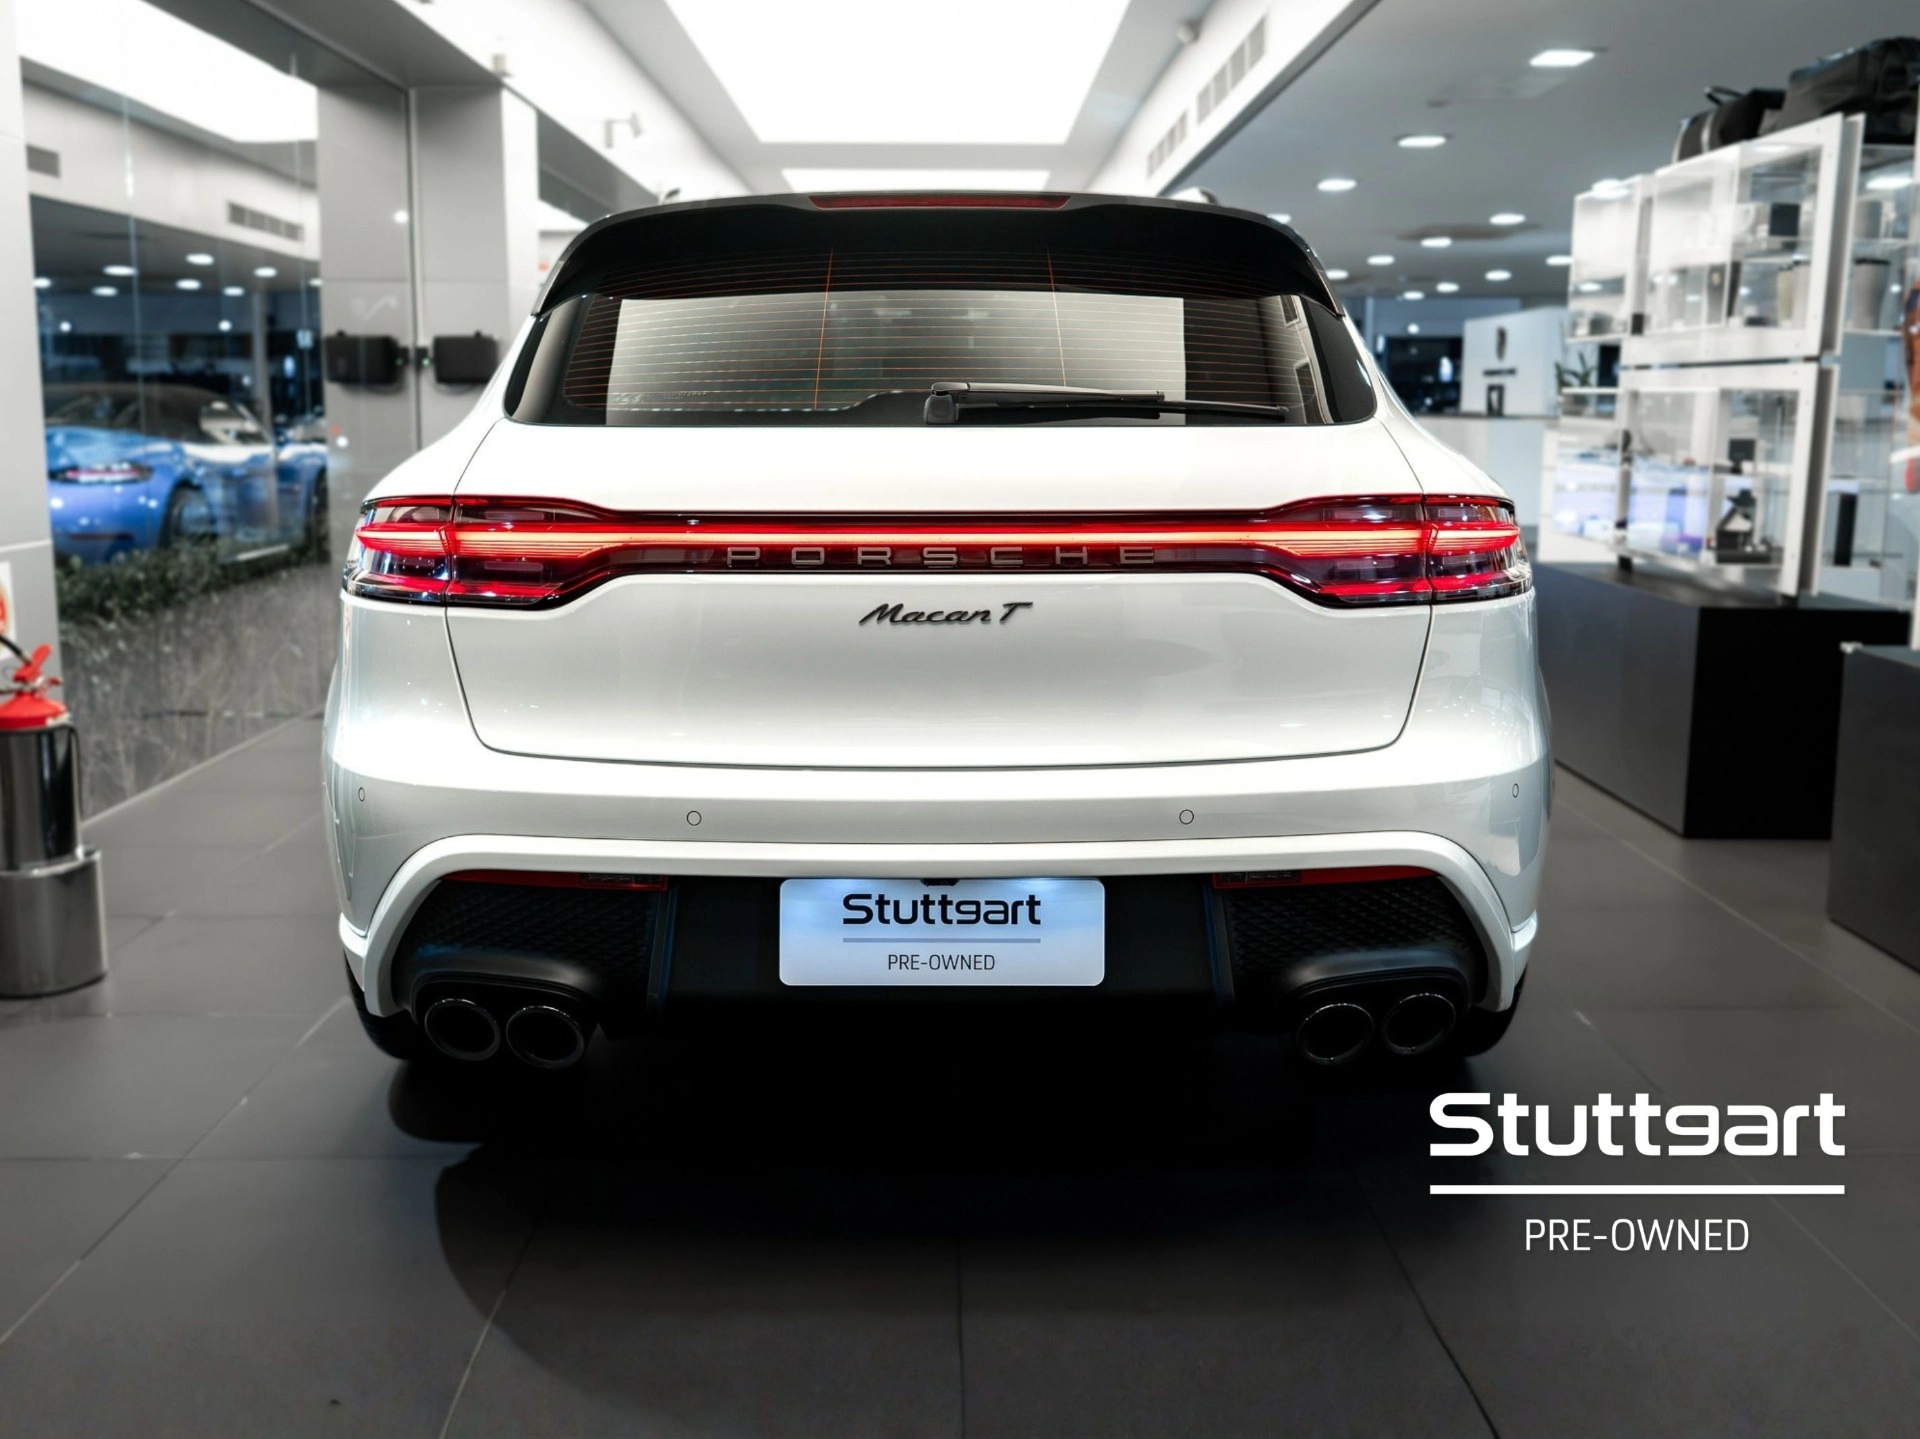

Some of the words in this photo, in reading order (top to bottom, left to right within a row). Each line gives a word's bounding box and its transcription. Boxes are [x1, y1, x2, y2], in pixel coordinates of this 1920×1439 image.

[726, 546, 1154, 566] PORSCHE
[858, 602, 992, 625] Macan
[999, 601, 1034, 625] T
[842, 893, 1042, 926] Stuttgart
[887, 954, 996, 971] PRE-OWNED
